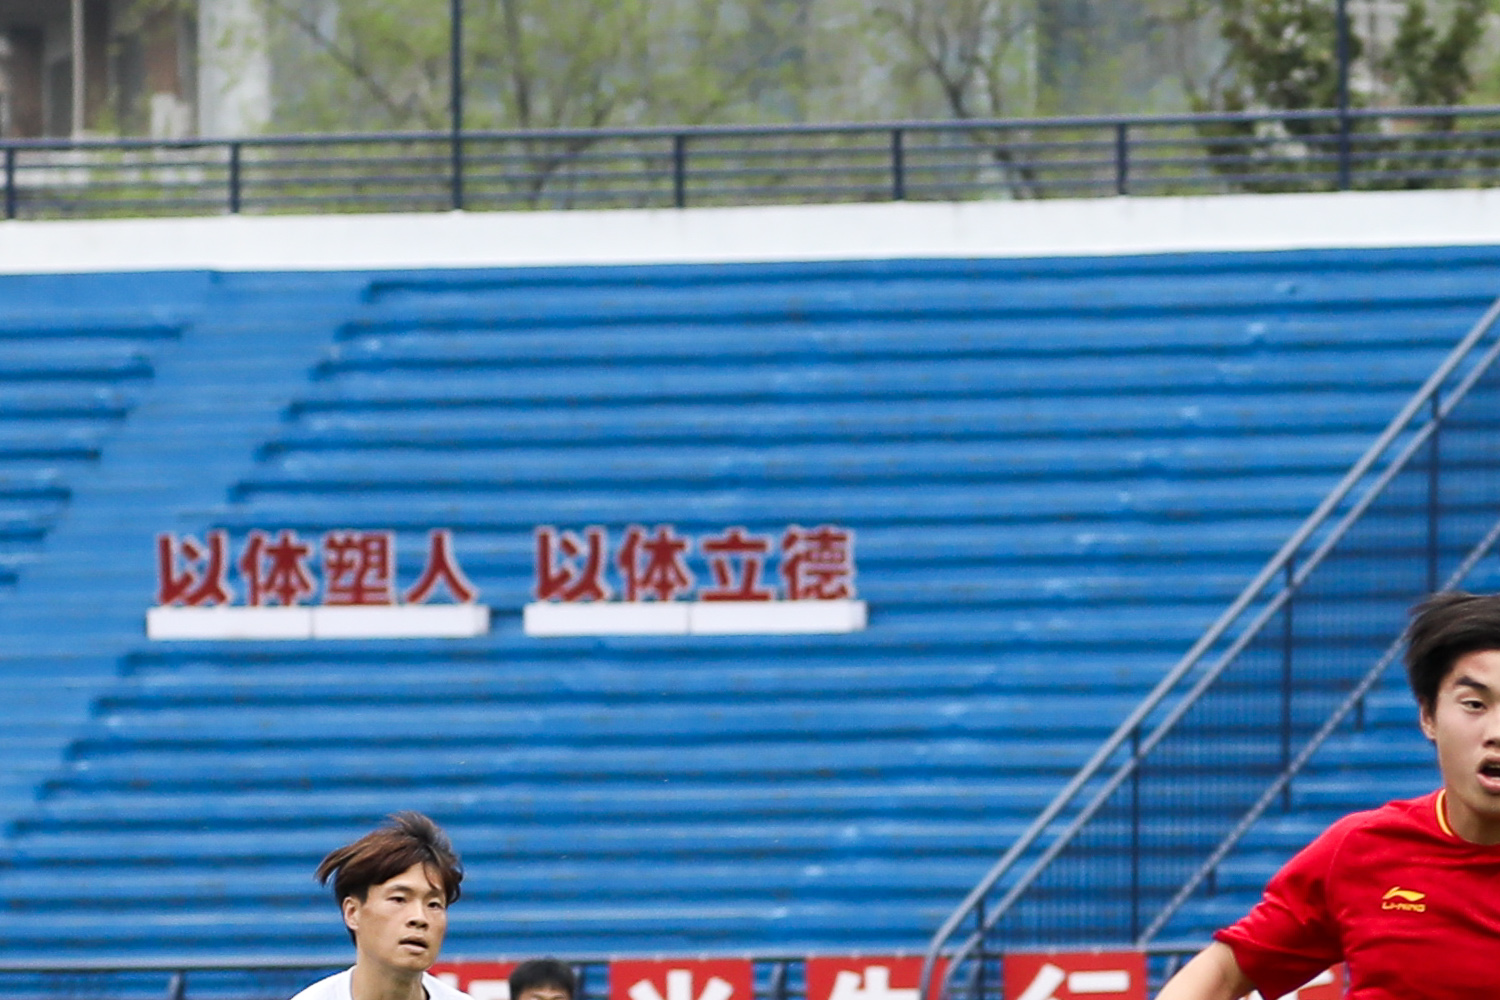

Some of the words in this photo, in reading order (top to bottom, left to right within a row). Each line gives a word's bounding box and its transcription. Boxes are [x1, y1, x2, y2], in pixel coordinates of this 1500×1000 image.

[156, 529, 478, 607] 以体塑人
[533, 524, 860, 603] 以体立德
